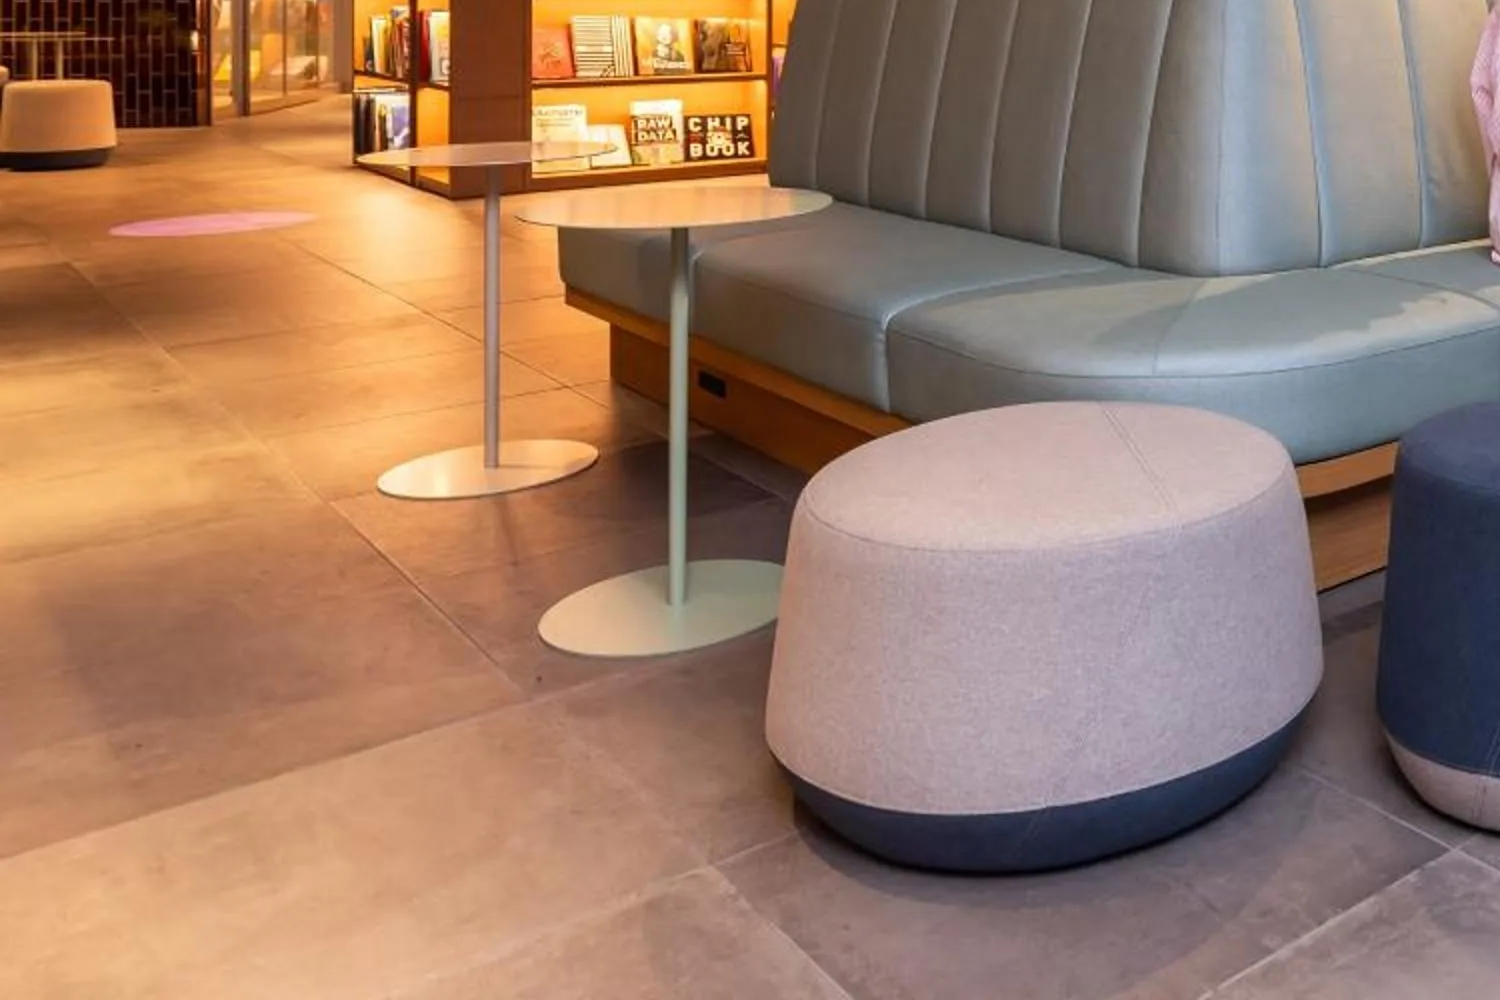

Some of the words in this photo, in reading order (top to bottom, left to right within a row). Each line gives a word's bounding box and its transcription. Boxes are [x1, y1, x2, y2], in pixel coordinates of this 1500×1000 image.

[637, 116, 672, 129] RAW
[688, 115, 749, 132] CHIP
[637, 129, 675, 141] DATA
[689, 141, 750, 157] BOOK
